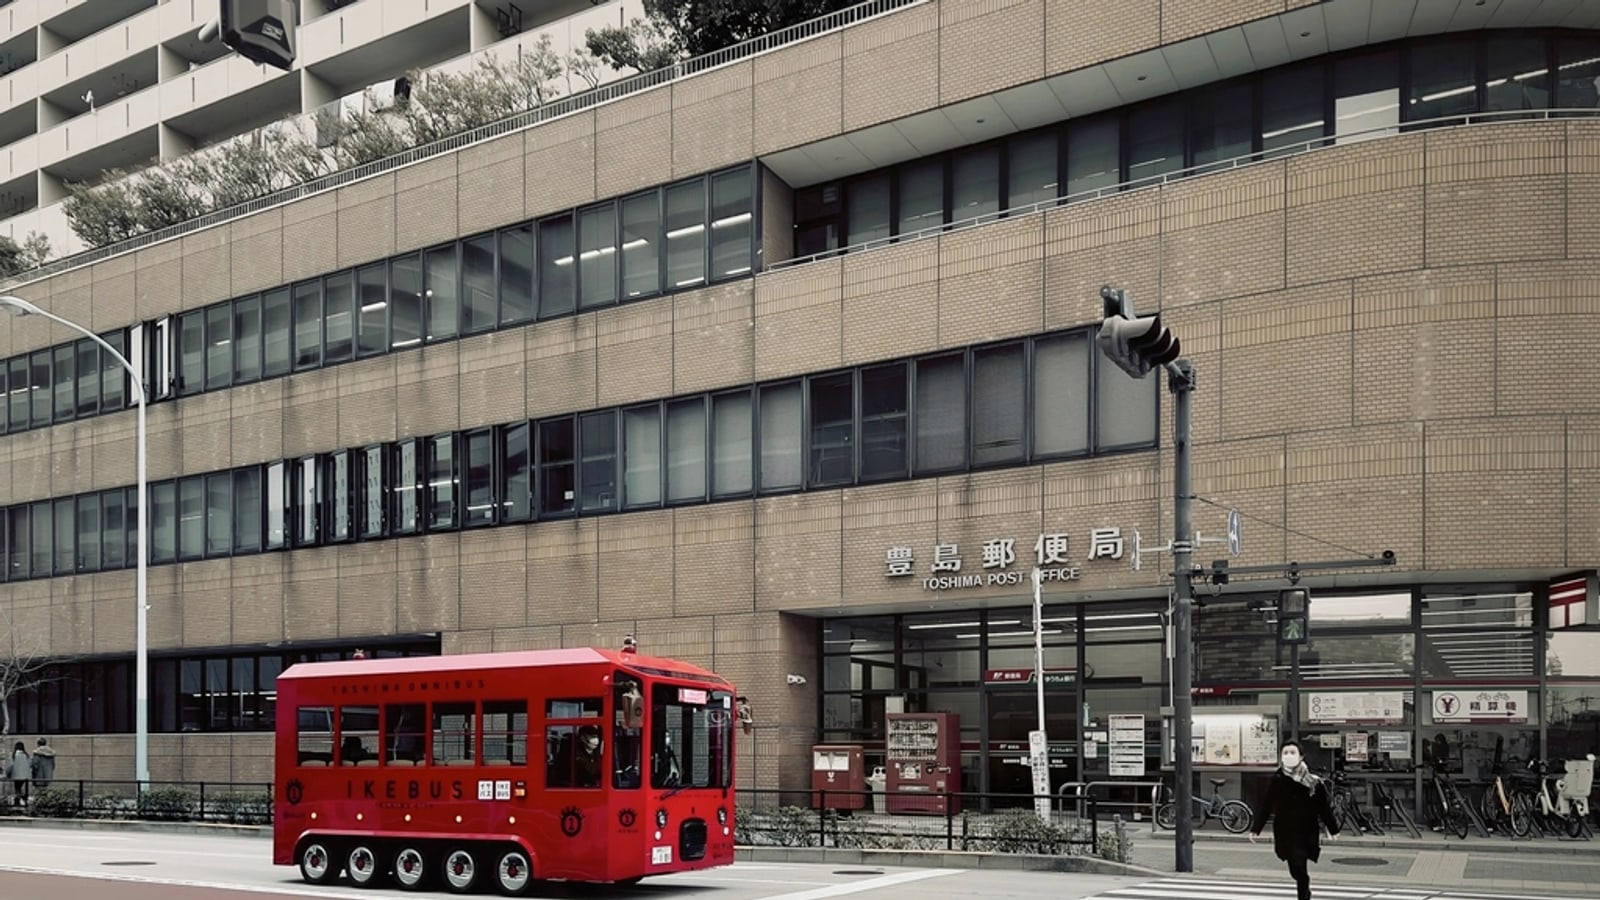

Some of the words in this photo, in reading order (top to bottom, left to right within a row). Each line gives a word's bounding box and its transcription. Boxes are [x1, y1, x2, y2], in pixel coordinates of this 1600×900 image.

[885, 527, 1123, 577] 豊島郵便局
[922, 574, 983, 590] TOSHIMA
[987, 572, 1024, 585] POST
[1031, 568, 1079, 583] FFICE
[408, 679, 485, 691] OMNIBUS
[347, 780, 464, 799] IKEBUS
